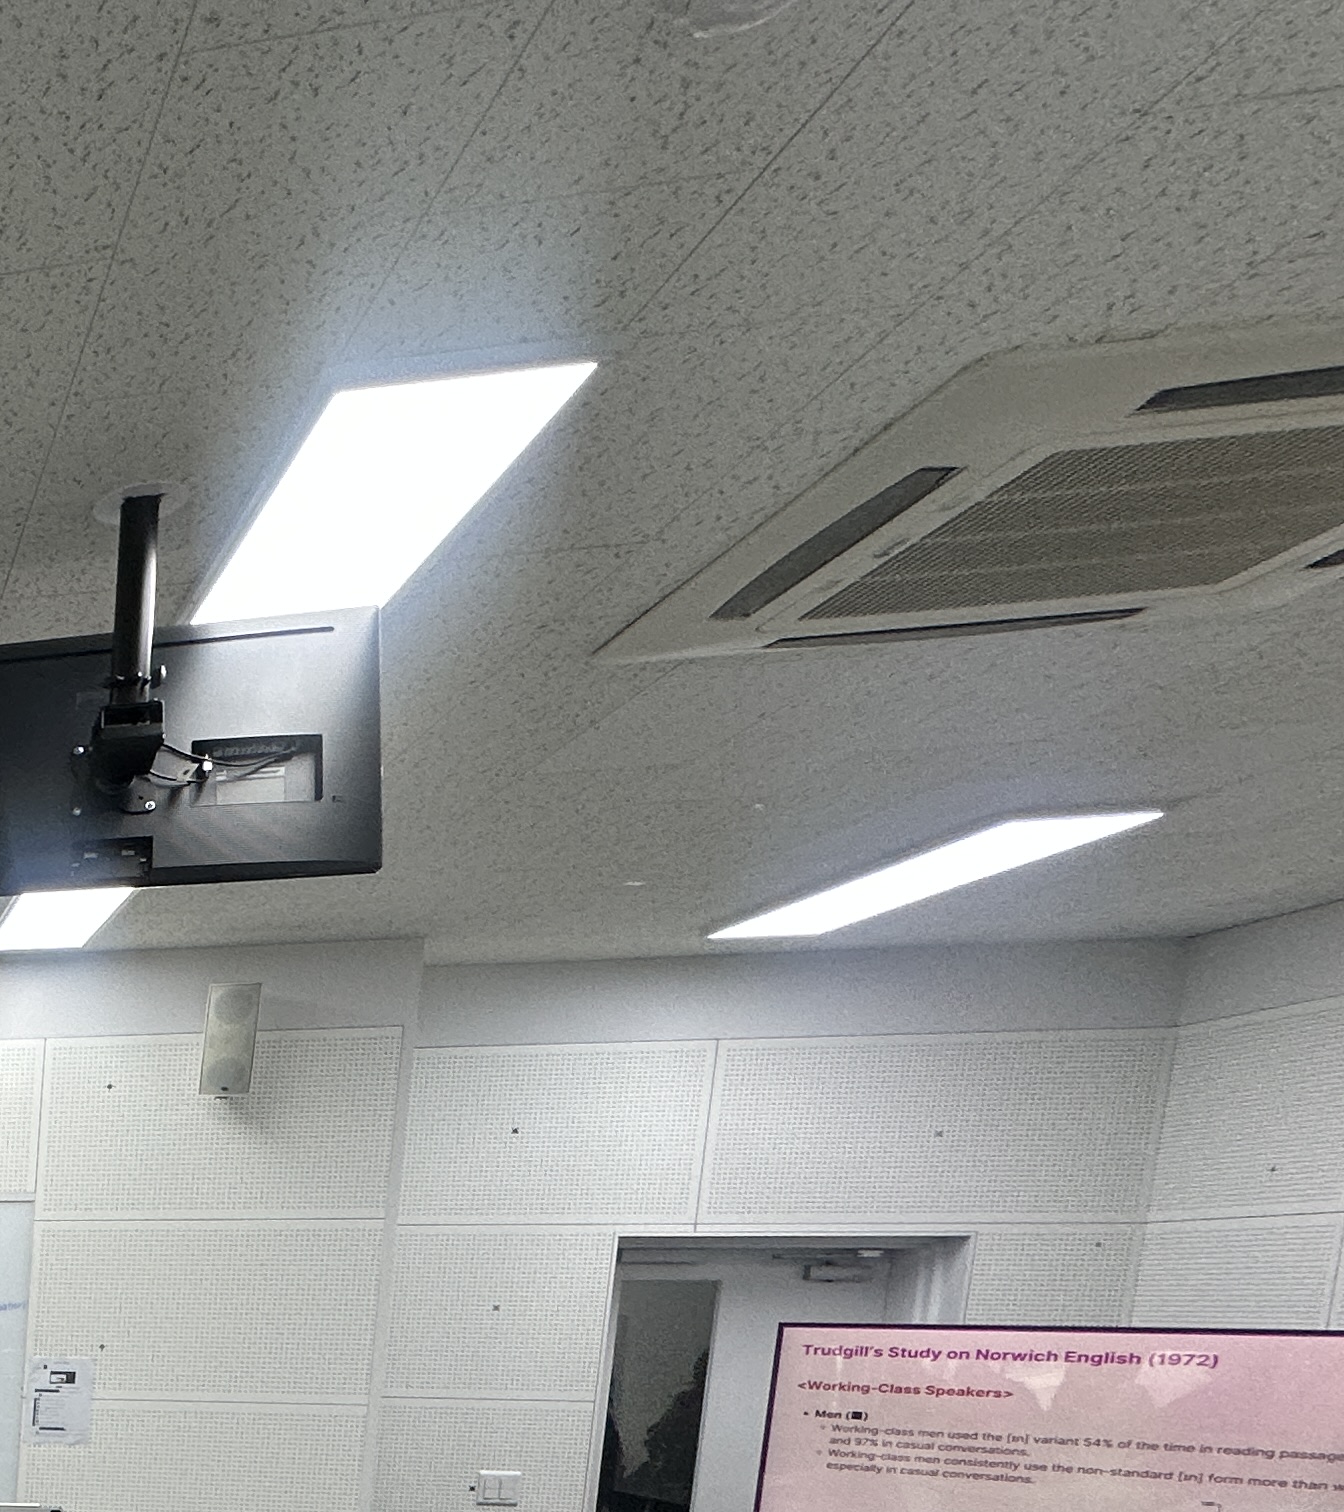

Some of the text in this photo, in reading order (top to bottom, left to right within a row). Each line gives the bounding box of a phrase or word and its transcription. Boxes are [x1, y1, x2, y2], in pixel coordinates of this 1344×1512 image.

[803, 1344, 1218, 1369] Trudgill's Study on Norwich English (1972)
[797, 1380, 1014, 1399] <Working-Class Speakers>
[815, 1409, 842, 1420] Men
[829, 1436, 850, 1446] and
[854, 1437, 878, 1447] 97%
[882, 1439, 893, 1448] in
[896, 1440, 935, 1451] casual
[831, 1424, 915, 1437] Working-class
[918, 1429, 944, 1438] men
[948, 1430, 978, 1441] used
[982, 1432, 1001, 1442] the
[1033, 1435, 1079, 1446] variant
[1083, 1437, 1113, 1448] 54%
[1118, 1439, 1132, 1449] of
[1136, 1440, 1159, 1451] the
[1163, 1443, 1195, 1453] time
[1200, 1444, 1212, 1454] in
[1217, 1446, 1276, 1460] reading
[827, 1460, 883, 1474] especially
[886, 1465, 896, 1474] in
[900, 1465, 939, 1477] casual
[828, 1448, 911, 1463] Working-class
[914, 1455, 940, 1465] men
[944, 1456, 1020, 1471] consistently
[1023, 1462, 1048, 1472] use
[1052, 1463, 1074, 1473] the
[1077, 1465, 1174, 1481] non-standard
[1208, 1473, 1243, 1485] form
[1247, 1476, 1288, 1489] more
[1292, 1478, 1328, 1491] than
